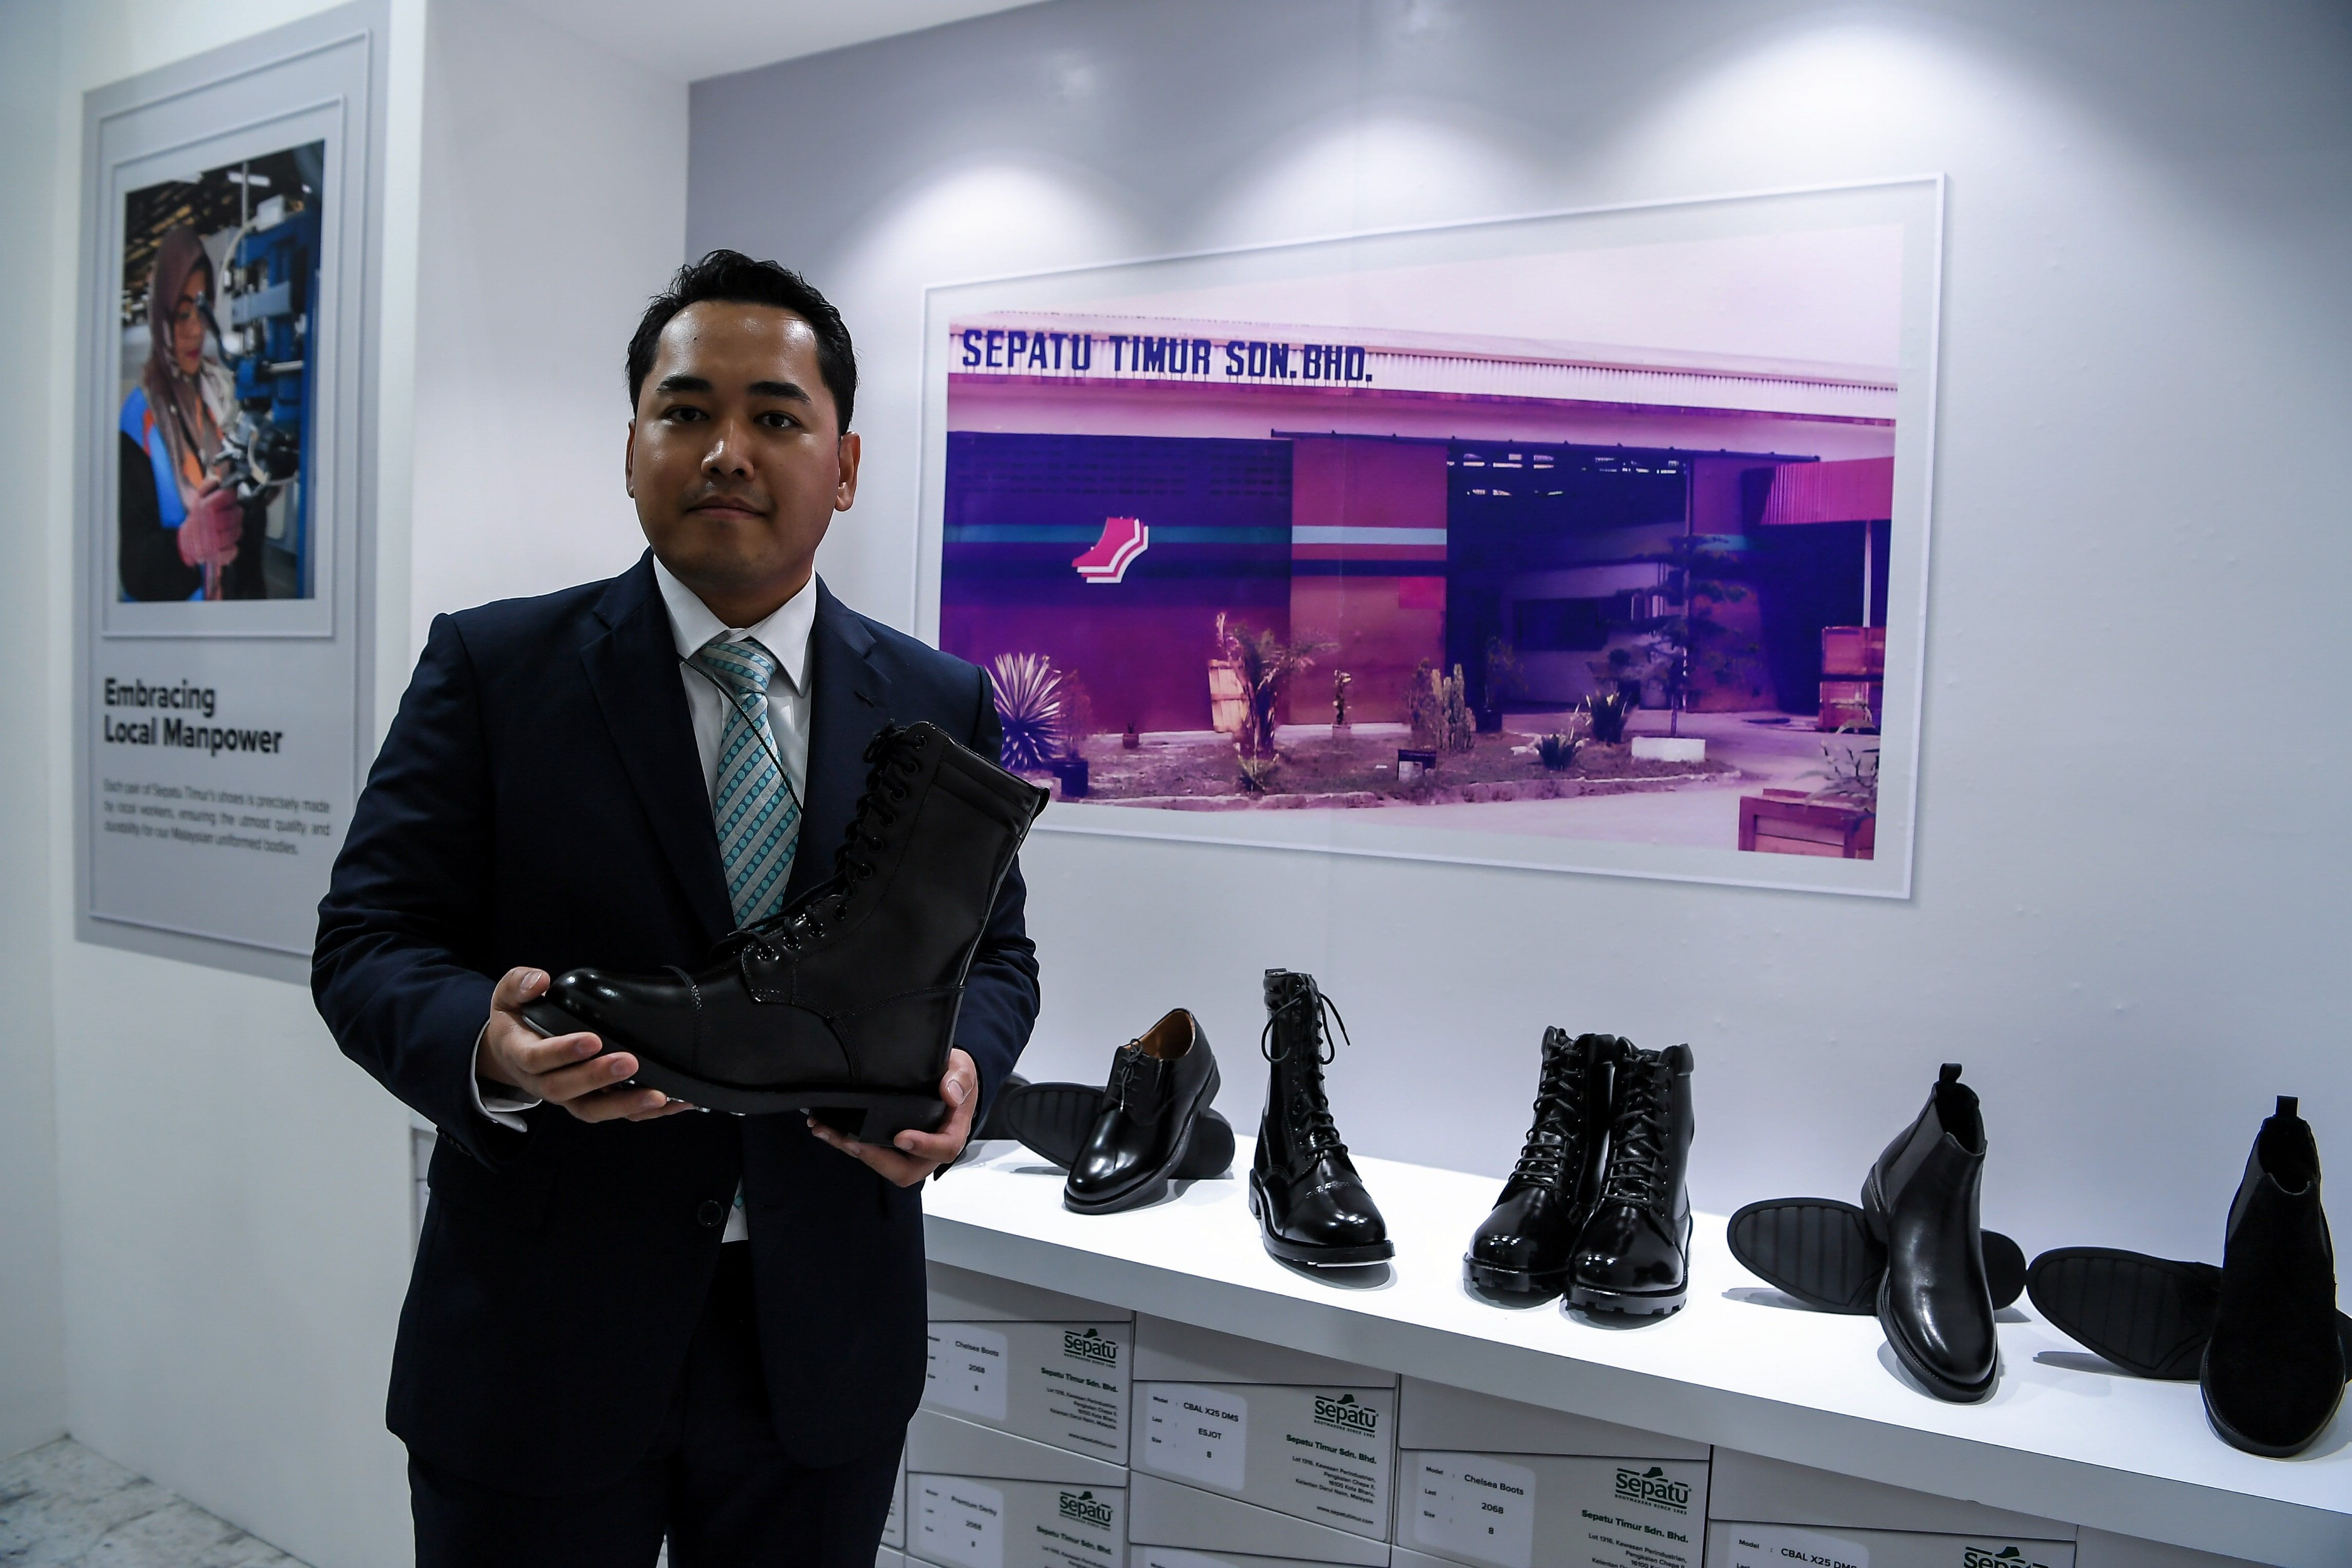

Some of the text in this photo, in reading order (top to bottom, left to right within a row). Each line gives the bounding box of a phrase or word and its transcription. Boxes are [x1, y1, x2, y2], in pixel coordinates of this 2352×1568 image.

[963, 330, 1091, 370] SEPATU
[1109, 335, 1211, 374] TIMUR
[104, 678, 215, 717] Embracing
[104, 715, 283, 757] Local Manpower
[302, 800, 330, 814] made
[220, 812, 235, 826] the
[275, 820, 307, 837] quality
[312, 823, 330, 836] and
[955, 1341, 999, 1356] Chelsea Boots
[1183, 1402, 1203, 1413] CBAL
[1205, 1407, 1219, 1417] X25
[1221, 1412, 1239, 1422] DMS
[1198, 1428, 1221, 1440] ESJOT
[1286, 1434, 1377, 1464] Sepatu Timur Sdn. Bhd.
[1426, 1466, 1443, 1475] Model
[1464, 1475, 1497, 1489] Chelsea
[1500, 1483, 1523, 1495] Boots
[1481, 1502, 1504, 1515] 2068
[1615, 1494, 1651, 1506] BOOTMAKERS
[1582, 1509, 1688, 1543] Sepatu Timur Sdn. Bhd.
[1739, 1539, 1759, 1549] Model
[1781, 1548, 1808, 1561] CBAL
[1811, 1555, 1831, 1566] X25
